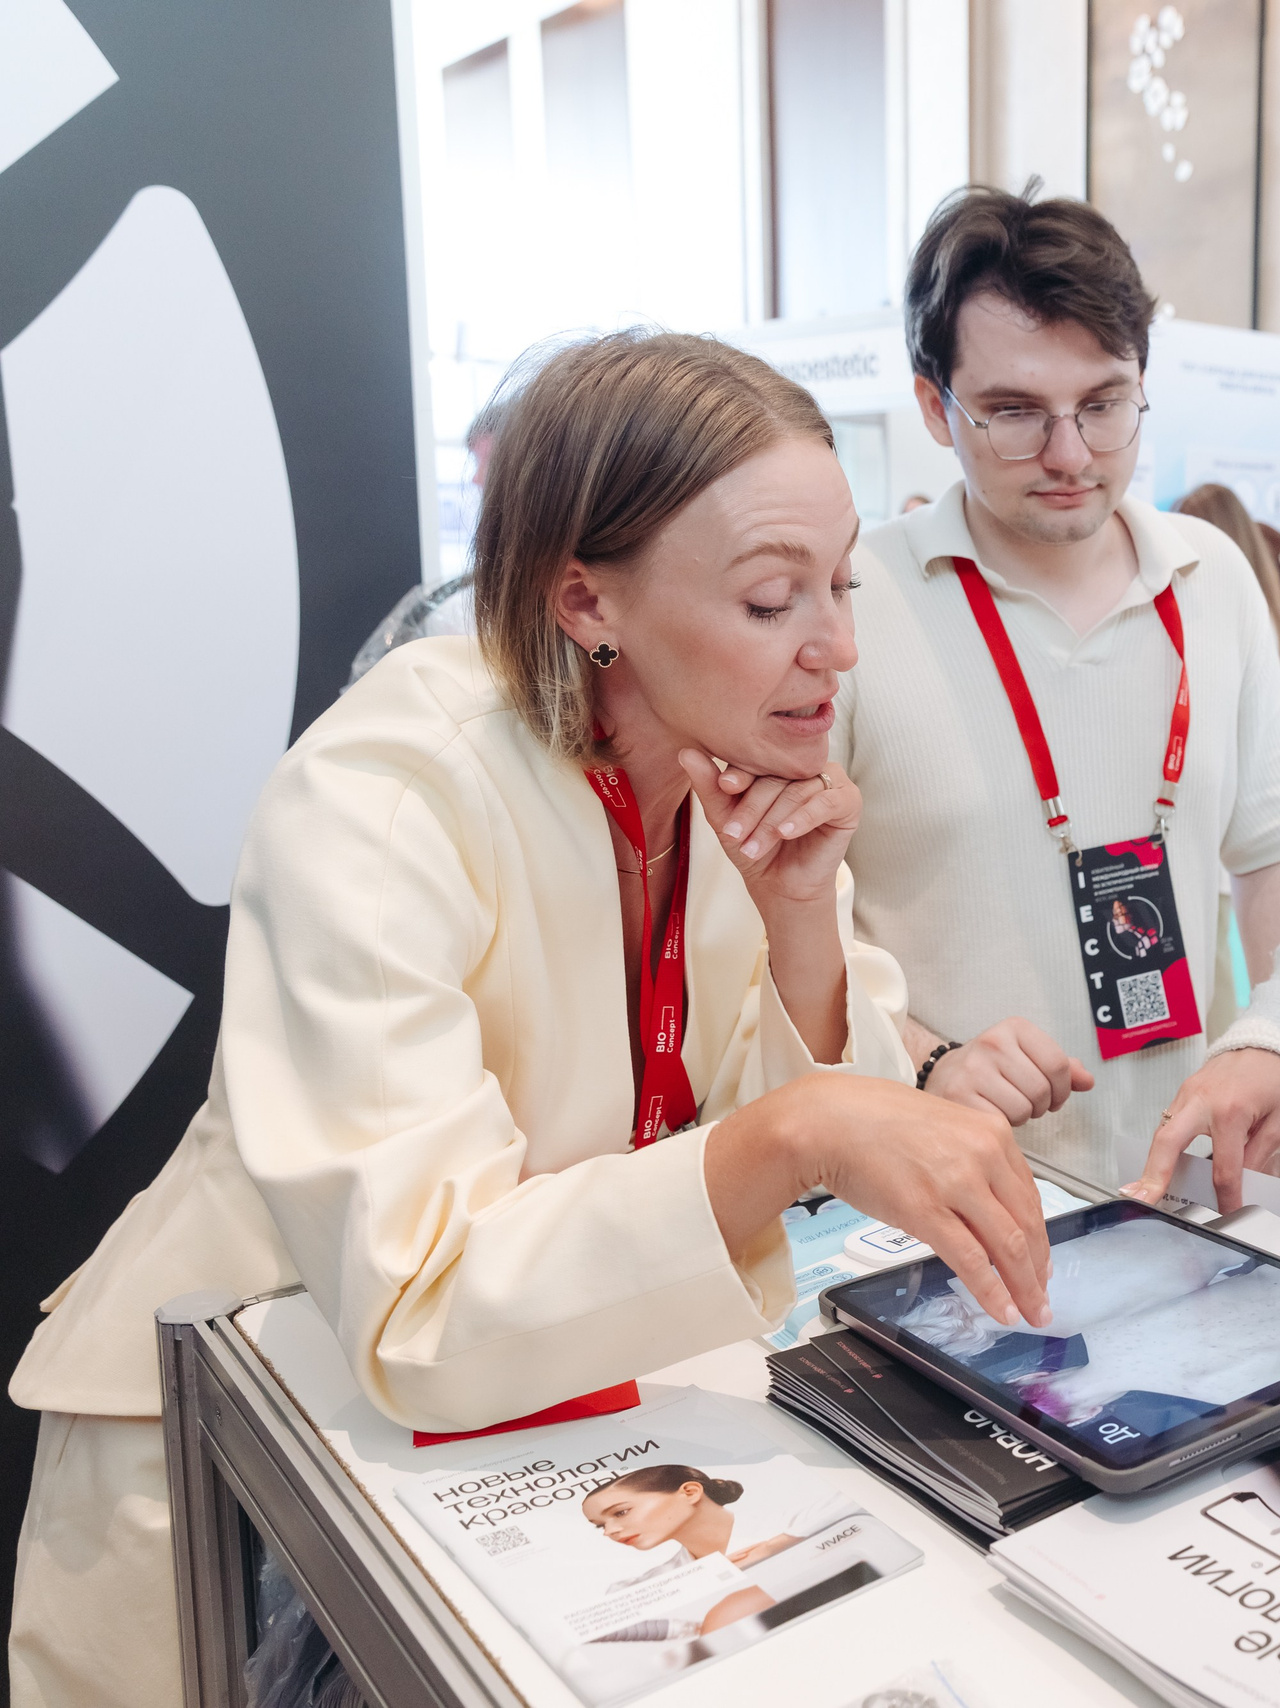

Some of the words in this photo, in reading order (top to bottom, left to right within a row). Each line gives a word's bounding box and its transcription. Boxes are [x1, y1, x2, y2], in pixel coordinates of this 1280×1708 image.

[593, 768, 612, 799] Concept
[664, 938, 672, 959] BIO
[656, 1031, 667, 1053] BIO
[667, 1019, 675, 1053] Concept
[643, 1119, 653, 1139] BIO
[433, 1459, 556, 1503] новые
[443, 1439, 660, 1515] технологии
[815, 1522, 861, 1552] VIVACE
